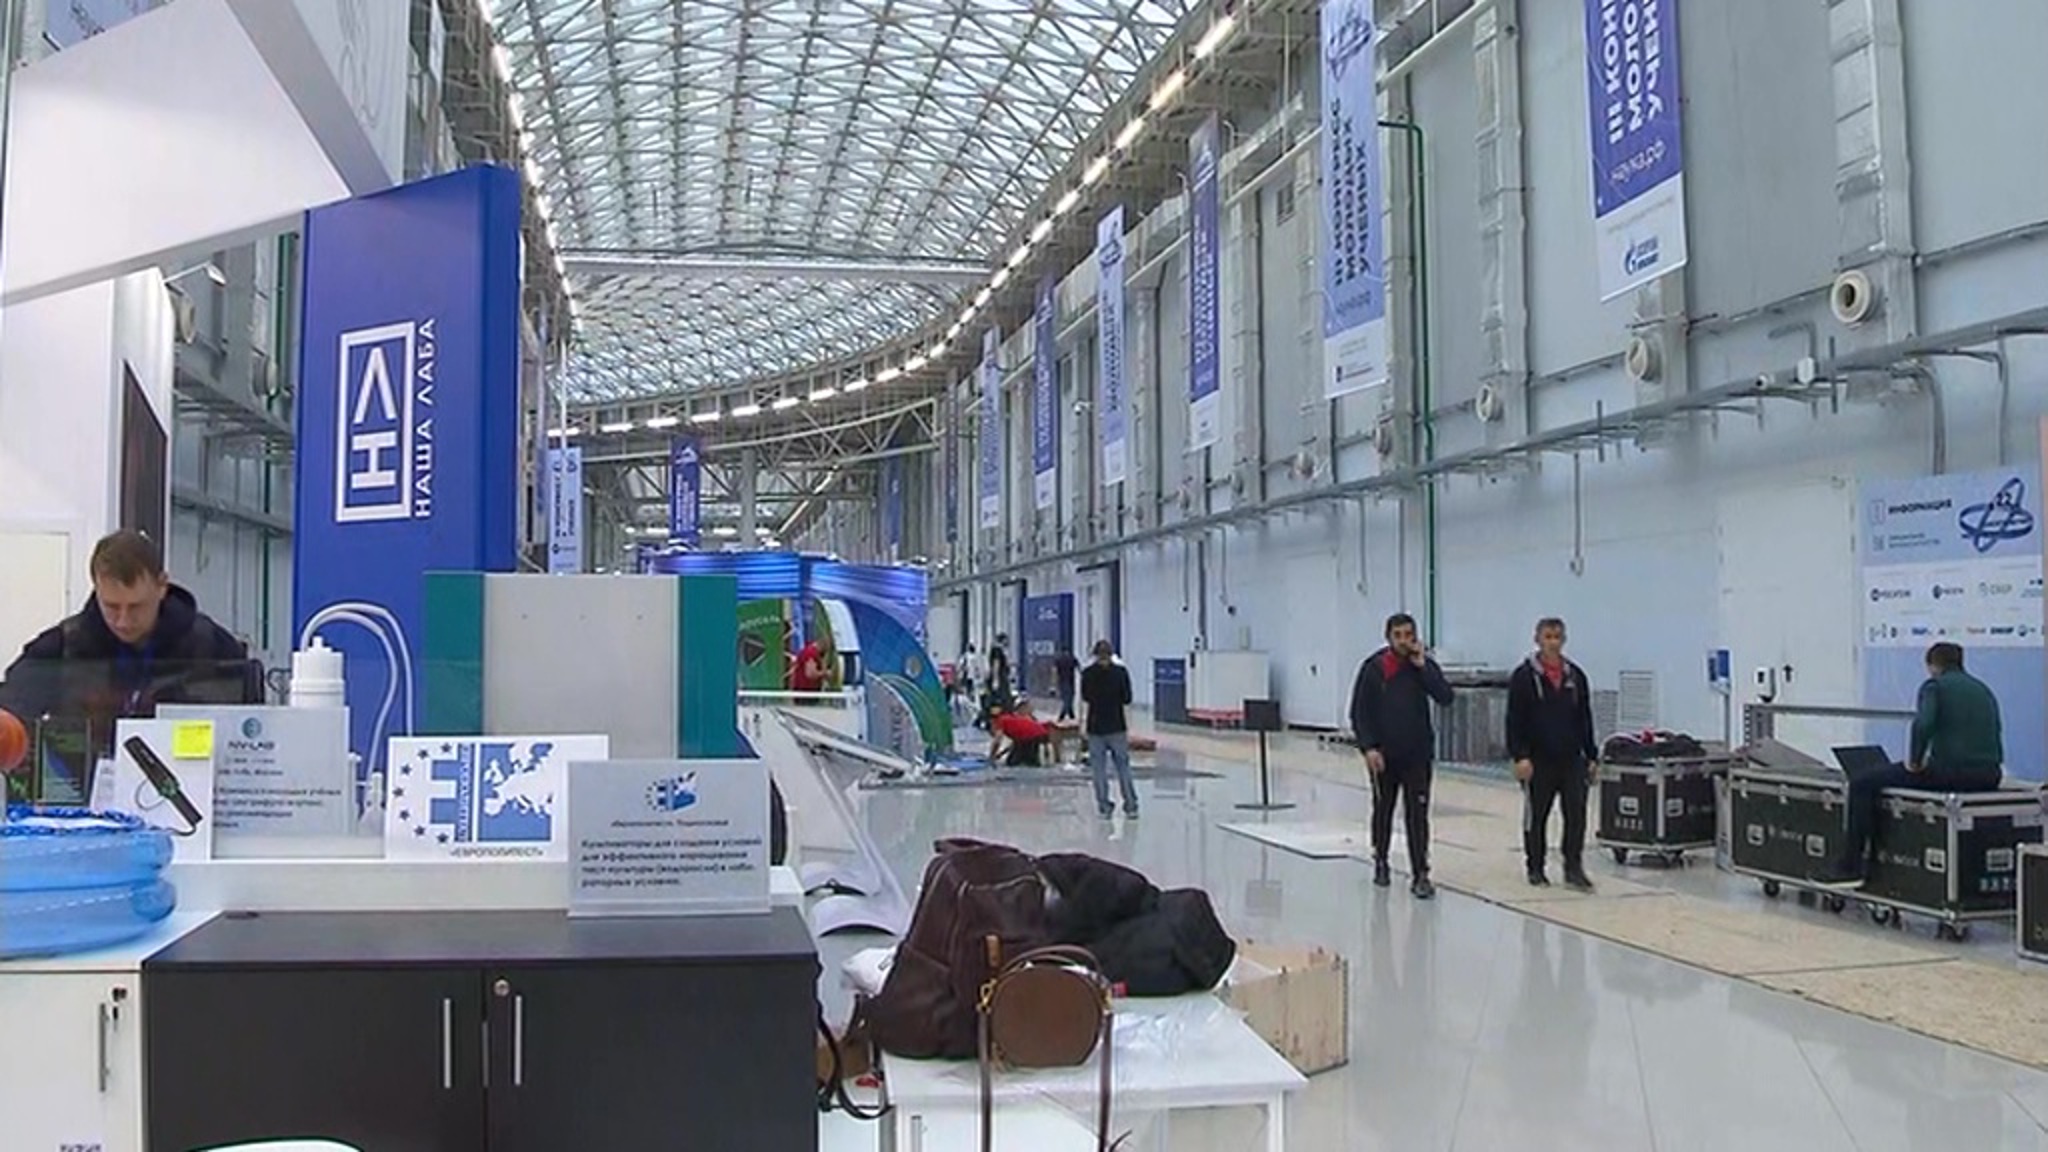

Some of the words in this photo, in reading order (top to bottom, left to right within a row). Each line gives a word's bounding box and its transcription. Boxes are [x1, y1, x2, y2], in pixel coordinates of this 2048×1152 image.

[1622, 0, 1643, 132] МОЛО
[417, 318, 435, 405] ЛАБА
[414, 418, 433, 517] НАША
